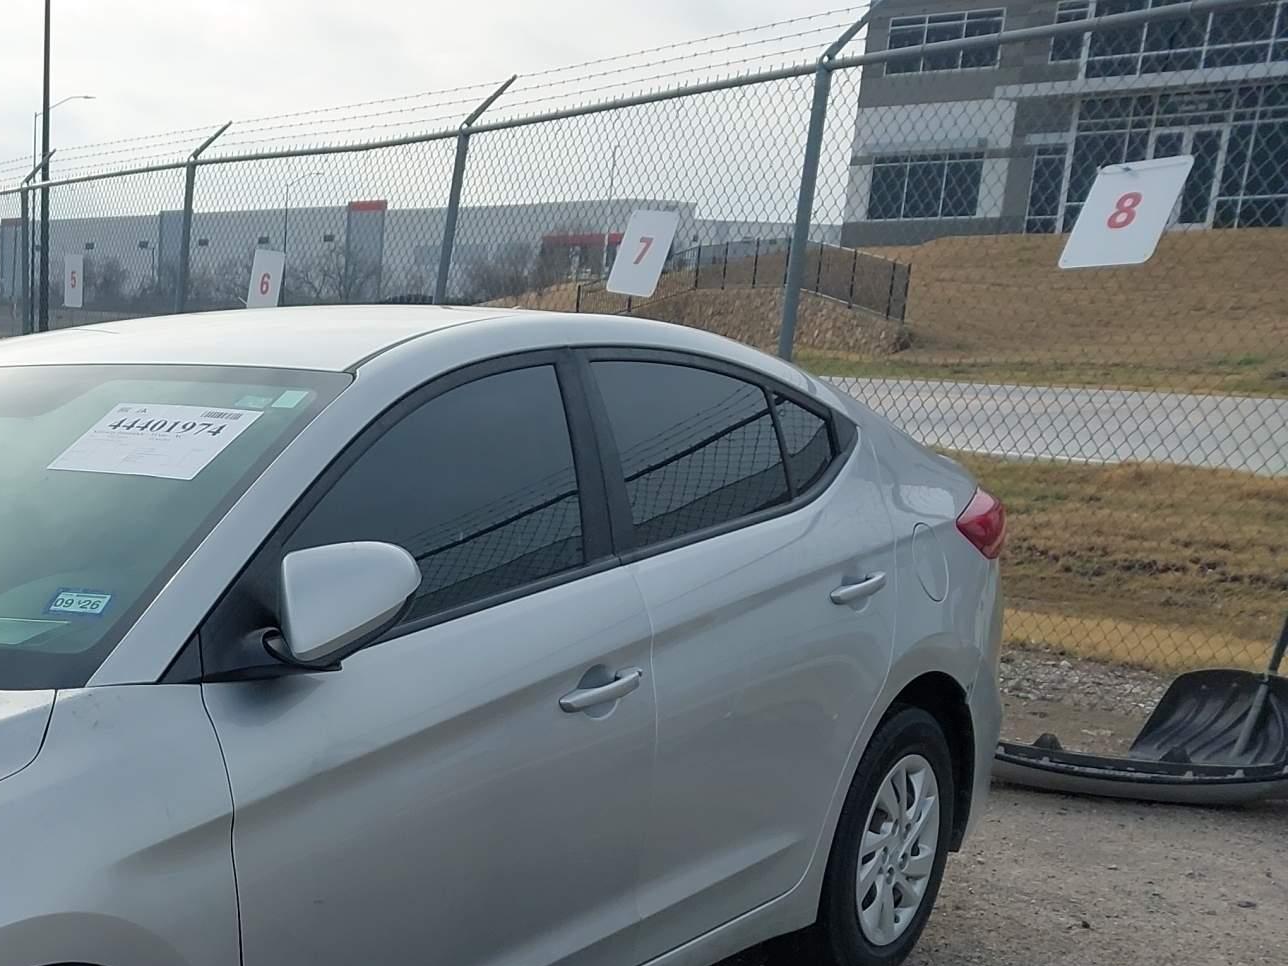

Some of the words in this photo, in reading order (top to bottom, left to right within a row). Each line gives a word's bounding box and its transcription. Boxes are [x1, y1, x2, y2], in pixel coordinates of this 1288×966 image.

[1107, 191, 1142, 229] 8
[633, 237, 654, 264] 7
[70, 270, 78, 289] 5
[260, 272, 271, 295] 6
[109, 416, 228, 437] 44401974
[54, 597, 75, 608] 09
